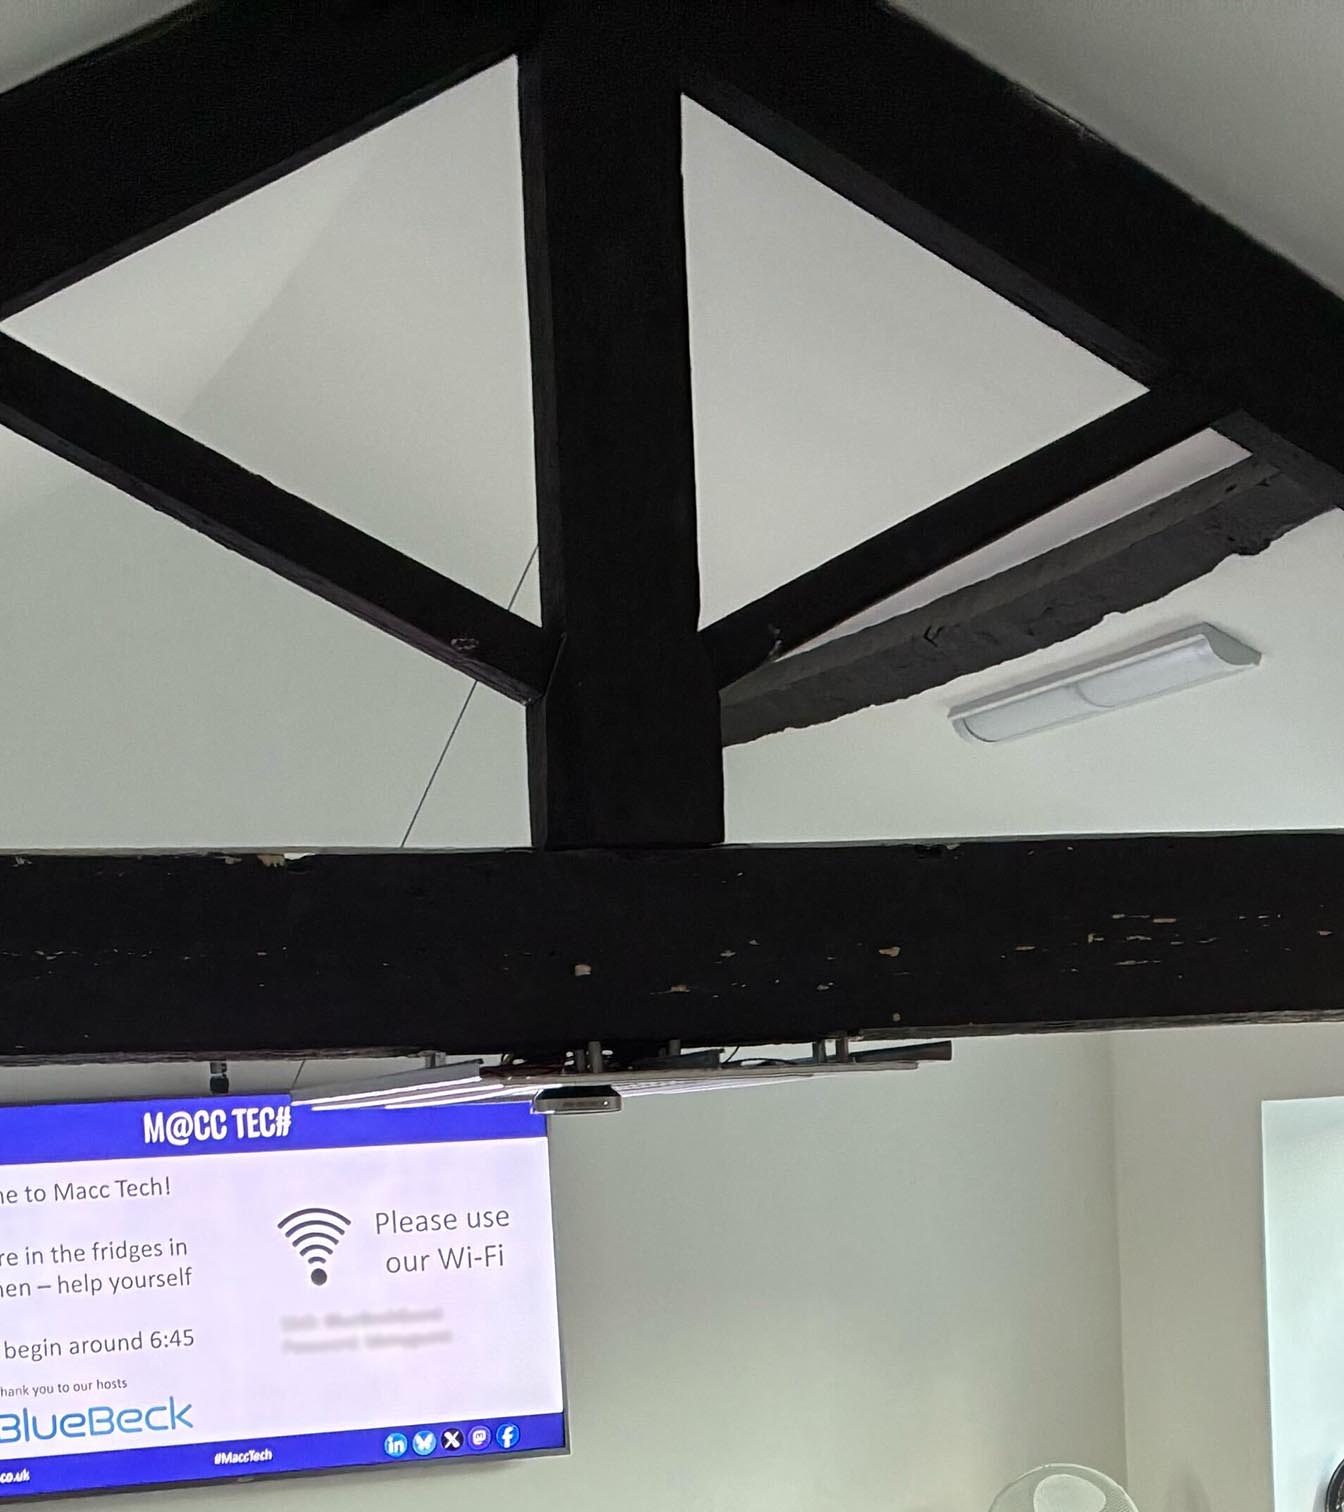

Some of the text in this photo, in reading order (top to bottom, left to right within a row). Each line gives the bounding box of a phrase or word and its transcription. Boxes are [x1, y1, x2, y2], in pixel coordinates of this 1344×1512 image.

[143, 1105, 292, 1146] M@CC TEC#
[25, 1186, 46, 1203] to
[54, 1182, 110, 1202] Macc
[115, 1176, 171, 1198] Tech!
[375, 1209, 510, 1235] Please use
[25, 1247, 44, 1265] in
[51, 1243, 86, 1264] the
[91, 1239, 163, 1262] fridges
[169, 1237, 188, 1257] in
[386, 1244, 504, 1274] our Wi-Fi
[58, 1272, 103, 1297] help
[108, 1266, 193, 1294] yourself
[4, 1338, 62, 1362] begin
[69, 1331, 143, 1356] around
[150, 1328, 194, 1350] 6:45
[32, 1384, 54, 1397] you
[57, 1382, 69, 1393] to
[73, 1381, 93, 1392] our
[96, 1378, 128, 1390] hosts
[213, 1448, 273, 1466] #MaccTech
